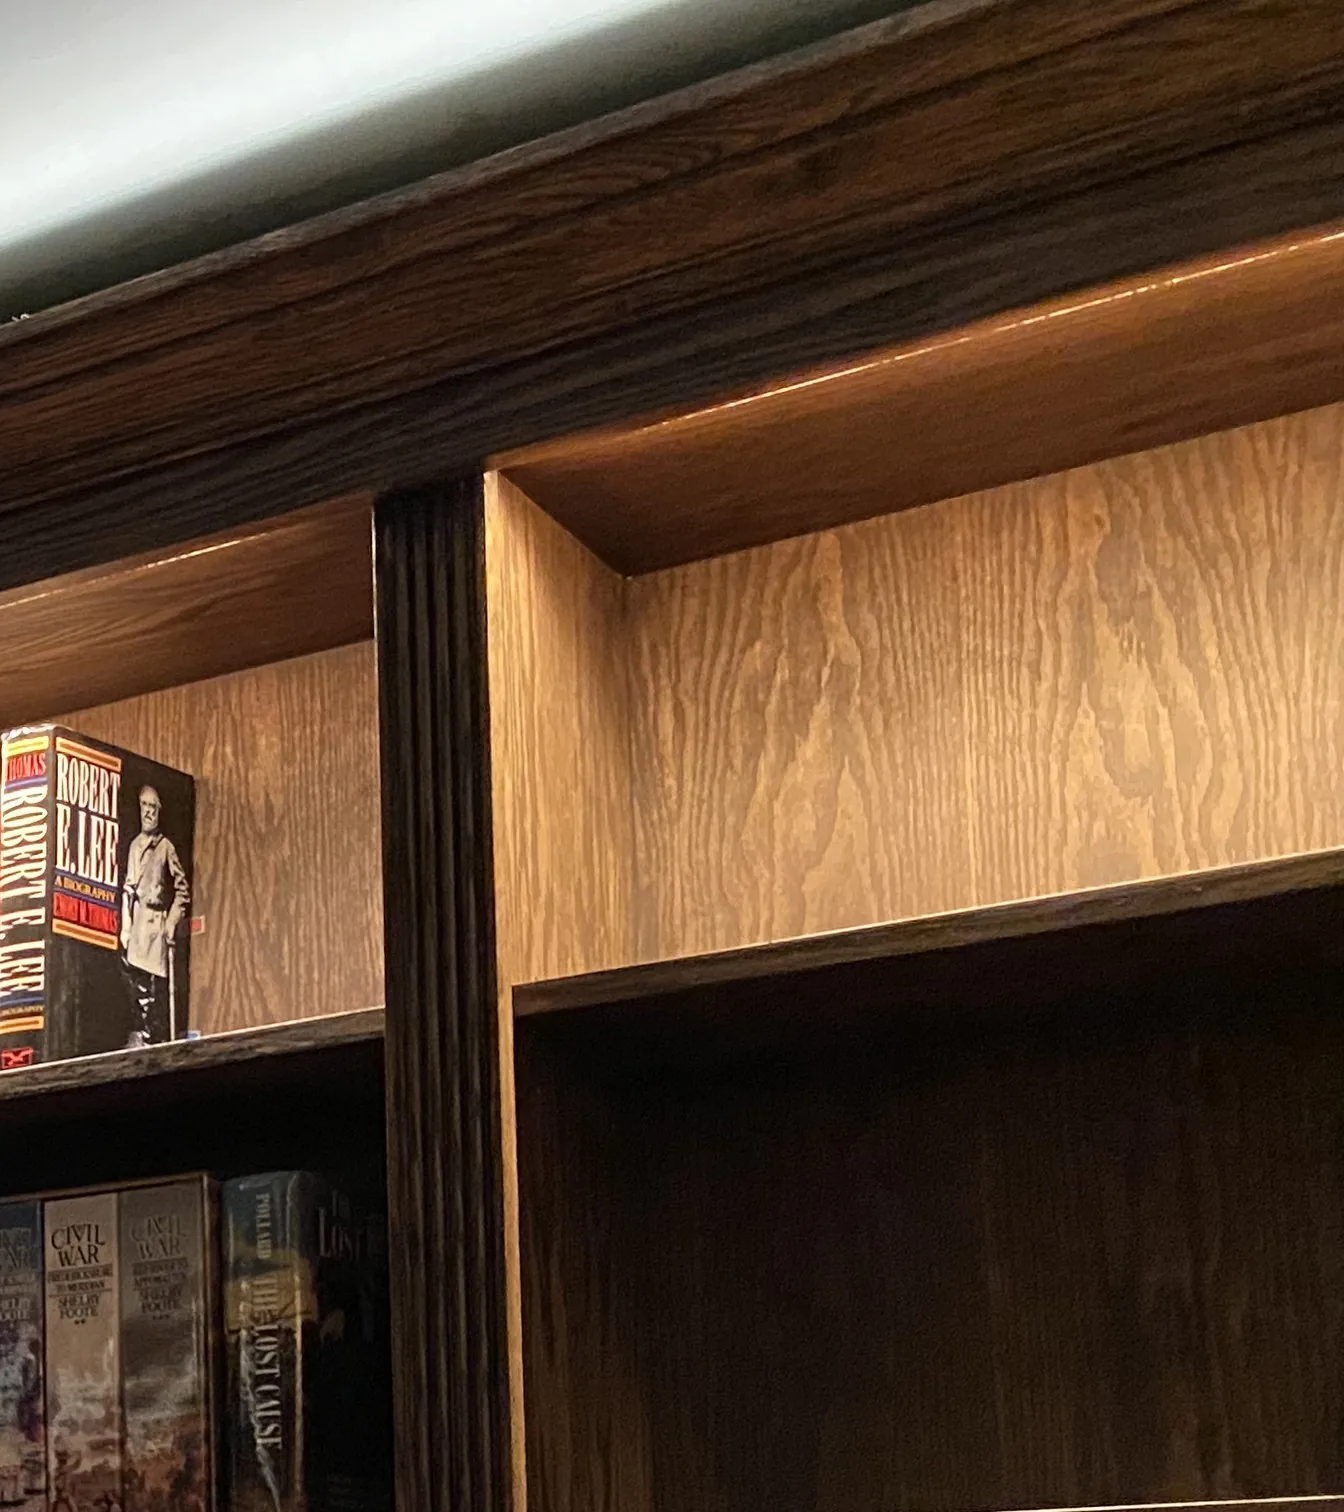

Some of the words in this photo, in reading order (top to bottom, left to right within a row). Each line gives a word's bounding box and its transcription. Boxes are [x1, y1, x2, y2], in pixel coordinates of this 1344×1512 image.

[6, 752, 47, 782] THOMAS
[56, 752, 121, 820] ROBERT
[1, 785, 48, 899] ROBERT
[56, 803, 77, 874] E.
[78, 812, 119, 888] LEE
[62, 878, 117, 905] BIOGRAPHY
[51, 1223, 106, 1250] CIVIL
[130, 1216, 188, 1243] CIVIL
[255, 1193, 272, 1260] POLLARD
[57, 1243, 100, 1267] WAR
[137, 1237, 183, 1261] WAR
[58, 1293, 100, 1308] SHELBY
[59, 1305, 99, 1320] FOOTE
[253, 1324, 282, 1378] LOST
[254, 1383, 284, 1449] CAUSE
